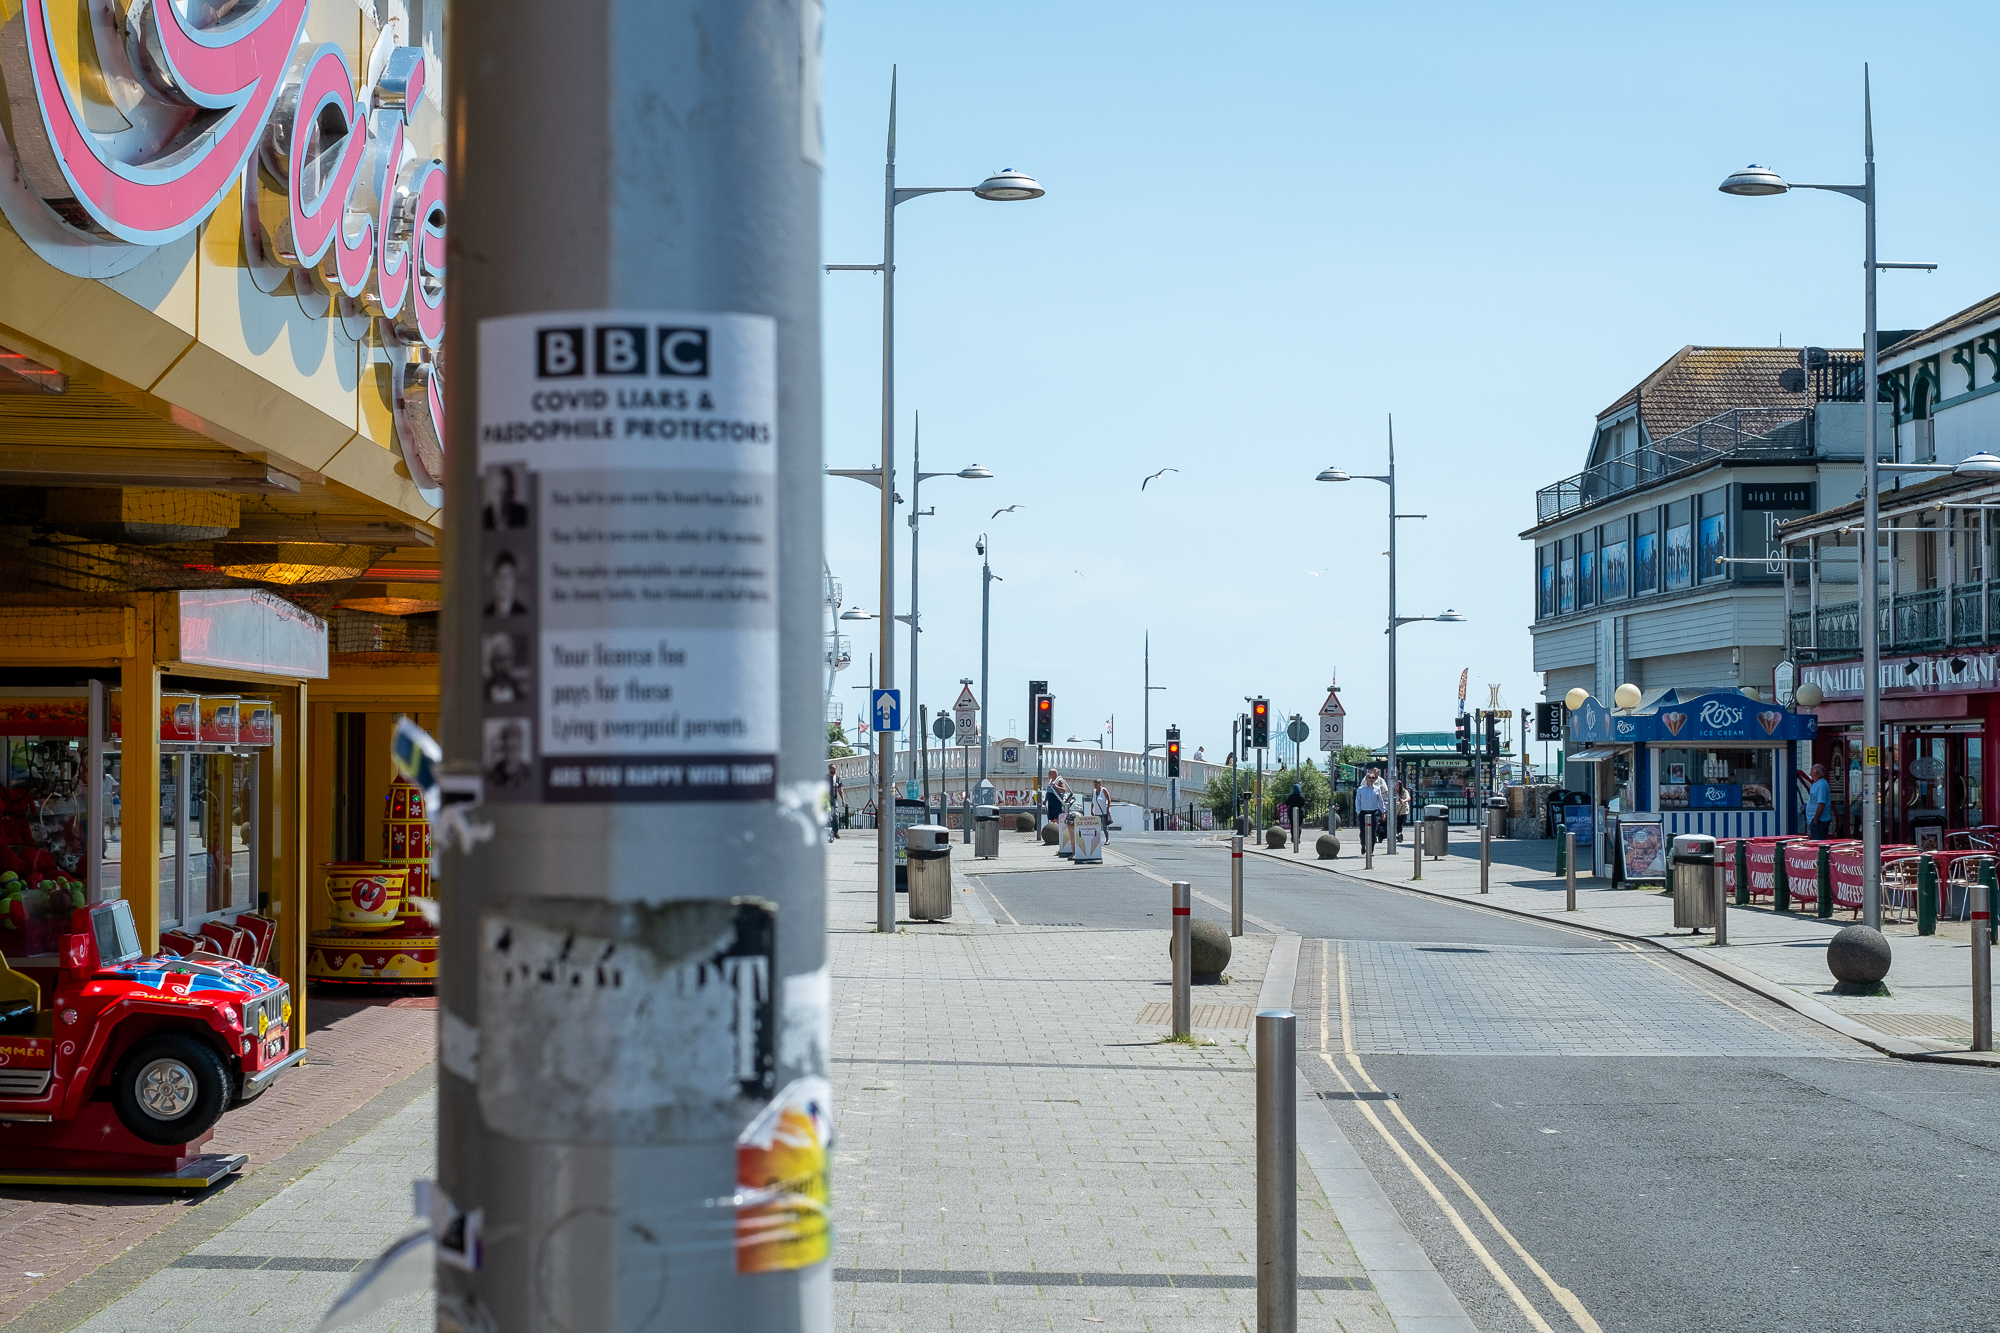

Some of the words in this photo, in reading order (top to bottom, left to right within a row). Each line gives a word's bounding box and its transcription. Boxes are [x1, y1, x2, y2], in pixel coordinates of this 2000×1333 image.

[540, 328, 707, 377] BBC
[530, 389, 610, 413] COVID
[617, 389, 690, 411] LIARS
[697, 390, 715, 411] &
[482, 417, 616, 444] PAEDOPHILE
[624, 416, 771, 443] PROTECTORS
[1748, 490, 1776, 503] night
[1784, 490, 1805, 502] club
[552, 643, 590, 668] Your
[593, 640, 654, 668] license
[658, 640, 687, 668] fee
[1879, 662, 1921, 689] ERICAN
[552, 682, 591, 710] pays
[595, 676, 621, 703] for
[625, 677, 674, 703] these
[553, 715, 598, 744] Lying
[602, 712, 680, 744] overpaid
[683, 716, 748, 743] perverts
[959, 718, 972, 728] 30
[1324, 723, 1339, 733] 30
[1550, 705, 1559, 739] cellar
[1700, 700, 1744, 729] Rossi
[551, 766, 583, 788] ARE
[585, 766, 622, 787] YOU
[624, 765, 684, 787] HAPPY
[686, 765, 729, 787] WITH
[144, 993, 212, 1004] HUMMER
[0, 1046, 45, 1057] MMER
